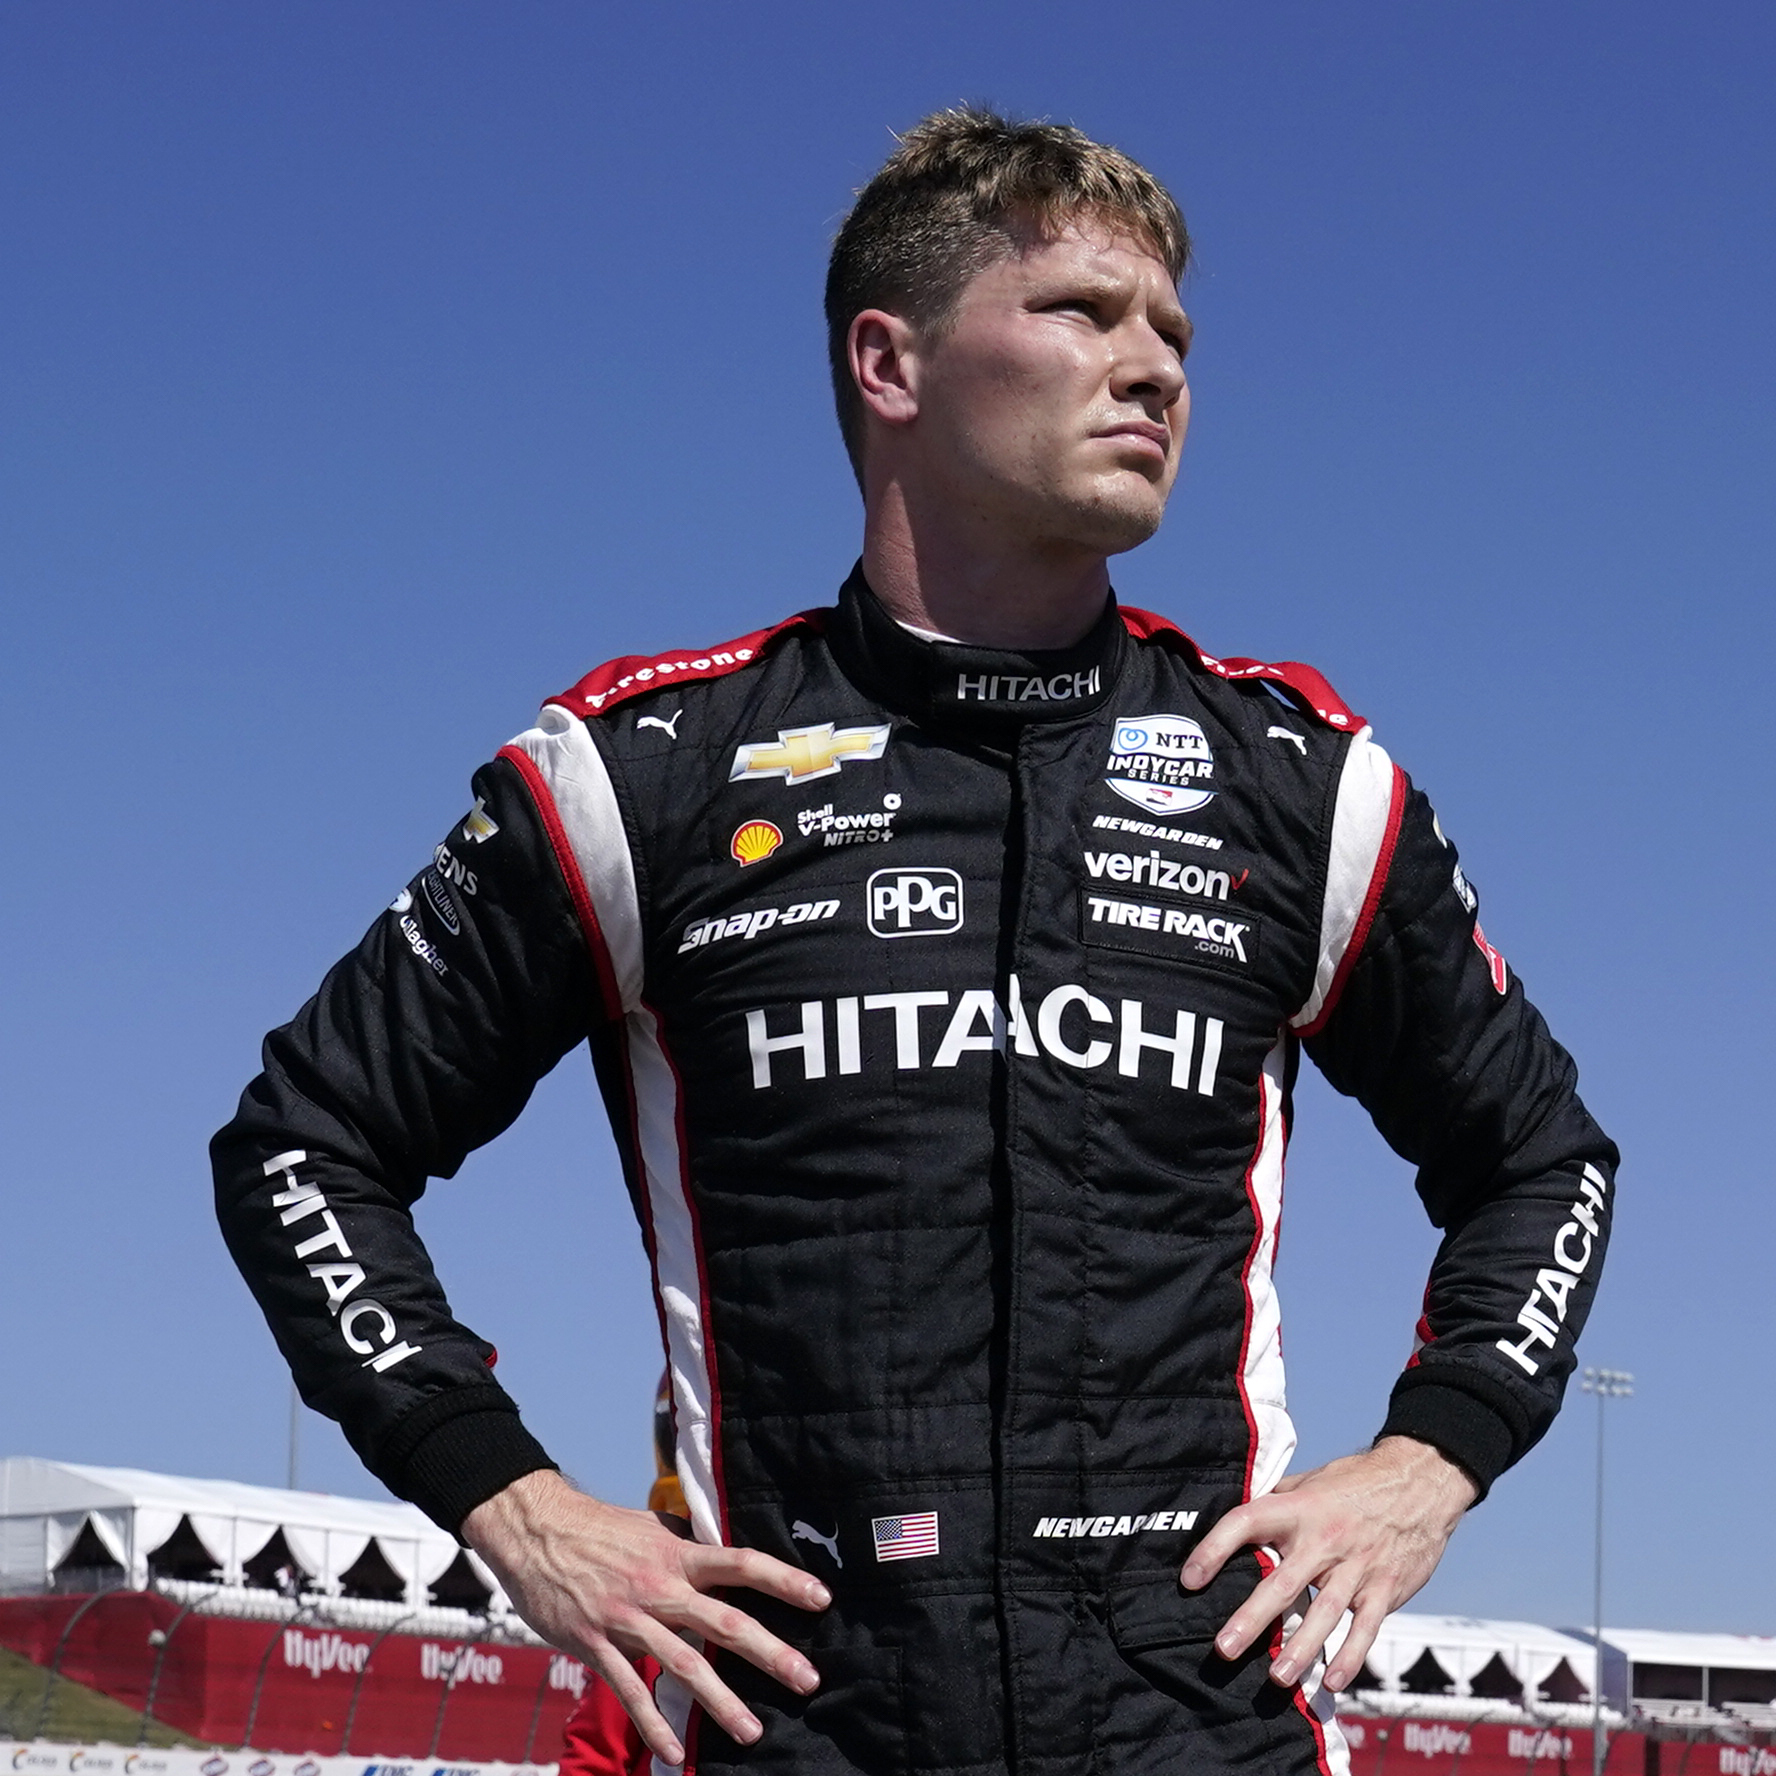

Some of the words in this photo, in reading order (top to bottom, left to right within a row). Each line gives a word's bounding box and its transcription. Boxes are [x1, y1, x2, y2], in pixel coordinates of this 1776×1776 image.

[957, 664, 1101, 700] HITACHI
[1155, 731, 1204, 750] NTT
[1106, 753, 1214, 780] INDYCAR
[1127, 768, 1190, 787] SERIES
[796, 802, 834, 825] Shell
[797, 811, 896, 838] V-Power
[1091, 814, 1224, 851] NEWGARDEN
[1083, 849, 1231, 901] verizon
[873, 876, 958, 928] PPG
[676, 898, 842, 955] Snap-on
[1087, 896, 1162, 931] TIRE
[1162, 908, 1248, 964] RACK
[1194, 939, 1236, 960] .com
[745, 973, 1225, 1097] HITACHI
[284, 1629, 371, 1679] HyVee
